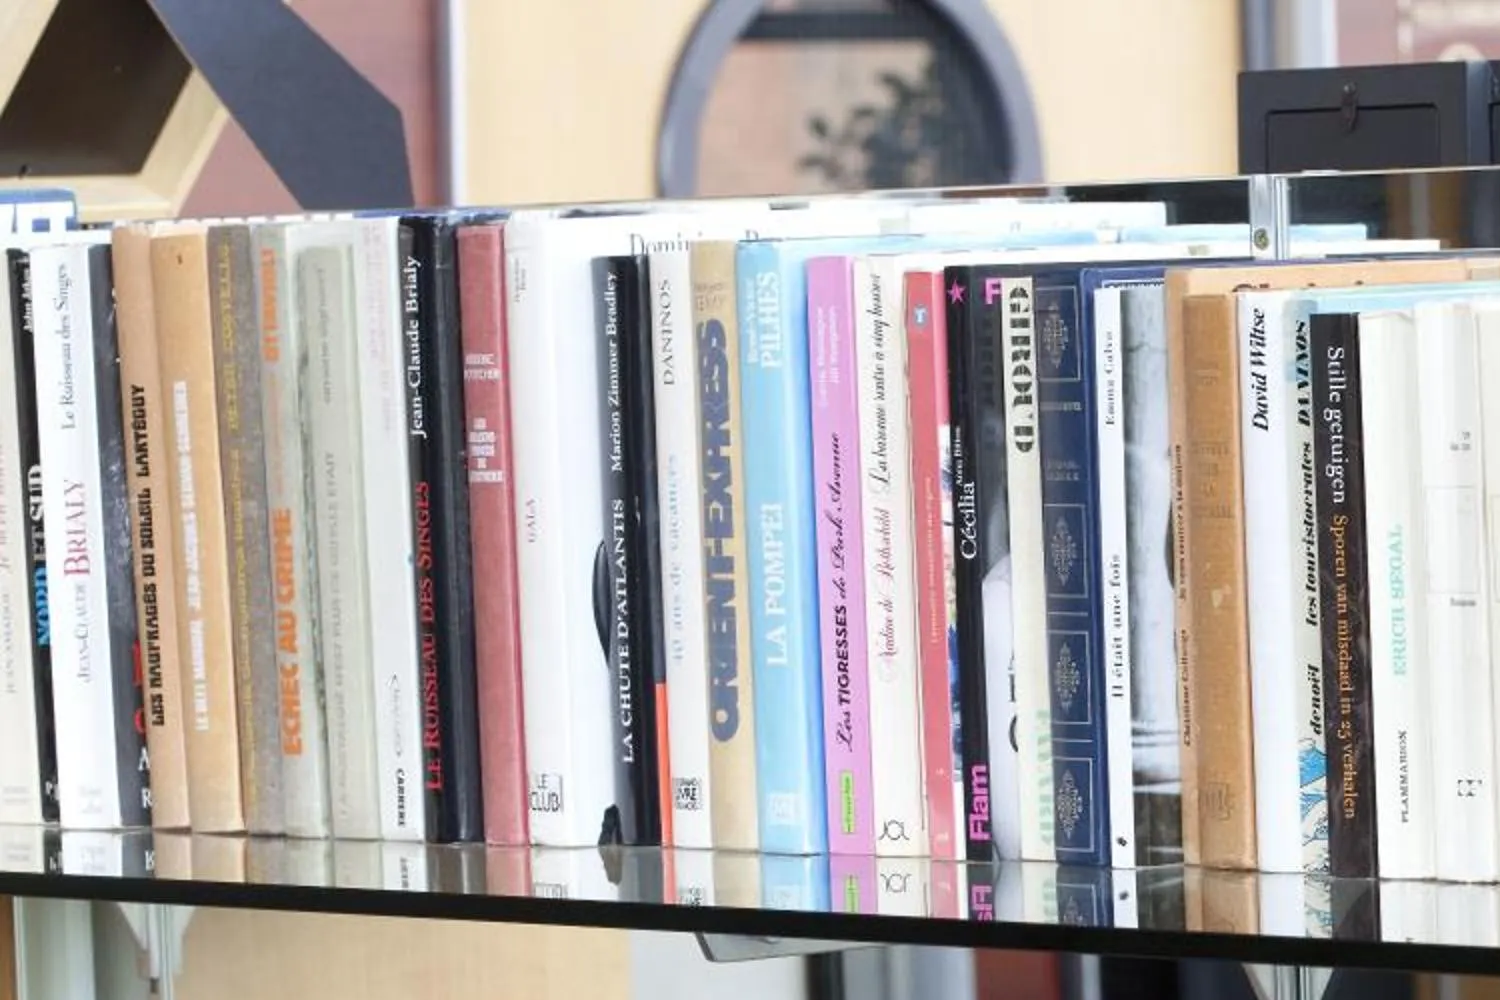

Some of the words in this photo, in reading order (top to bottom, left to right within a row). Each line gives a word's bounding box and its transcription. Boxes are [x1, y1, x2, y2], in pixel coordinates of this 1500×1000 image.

[52, 264, 73, 311] Singes
[404, 256, 421, 313] Brialy
[603, 271, 619, 337] Bradley
[54, 315, 71, 341] des
[658, 279, 676, 386] DANINOS
[755, 271, 783, 368] PILHES
[1248, 308, 1266, 368] Wiltse
[57, 343, 75, 405] Ruisseau
[406, 319, 427, 439] Jean-Claude
[605, 342, 620, 407] Zimmer
[1250, 371, 1269, 432] David
[1326, 345, 1346, 403] Stille
[60, 410, 76, 430] Le
[607, 411, 622, 472] Marion
[1324, 408, 1349, 504] getuigen
[28, 464, 44, 522] SUD
[138, 488, 154, 549] SOLEIL
[666, 453, 680, 552] vacances
[957, 482, 977, 560] Cécilia
[1300, 441, 1316, 593] touristocrates
[31, 523, 46, 561] ET
[414, 481, 432, 569] SINGES
[695, 319, 740, 743] ORIENT-EXPRESS
[1330, 514, 1349, 577] Sporen
[142, 555, 156, 577] DU
[272, 510, 295, 604] CRIME
[612, 499, 629, 639] D'ATLANTIS
[668, 562, 681, 586] de
[1108, 554, 1121, 588] fois
[1387, 528, 1405, 600] SEGAL
[33, 568, 51, 648] NORD
[417, 577, 434, 622] DES
[833, 577, 847, 600] de
[1110, 594, 1121, 628] une
[1305, 597, 1318, 627] les
[1337, 582, 1349, 613] van
[275, 610, 298, 654] AU
[765, 626, 788, 667] LA
[834, 605, 852, 707] TIGRESSES
[1110, 636, 1123, 679] était
[1338, 619, 1353, 691] misdaad
[1391, 605, 1407, 676] ERICH
[150, 693, 165, 726] LES
[277, 664, 303, 756] ECHEC
[420, 634, 442, 748] RUISSEAU
[617, 645, 633, 727] CHUTE
[1306, 664, 1322, 736] denoël
[1341, 697, 1353, 714] in
[620, 734, 635, 764] LA
[835, 710, 853, 753] Les
[1337, 720, 1353, 740] 25
[426, 759, 444, 791] LE
[529, 792, 561, 812] CLUB
[968, 764, 991, 842] Flam
[1343, 744, 1360, 819] verhalen
